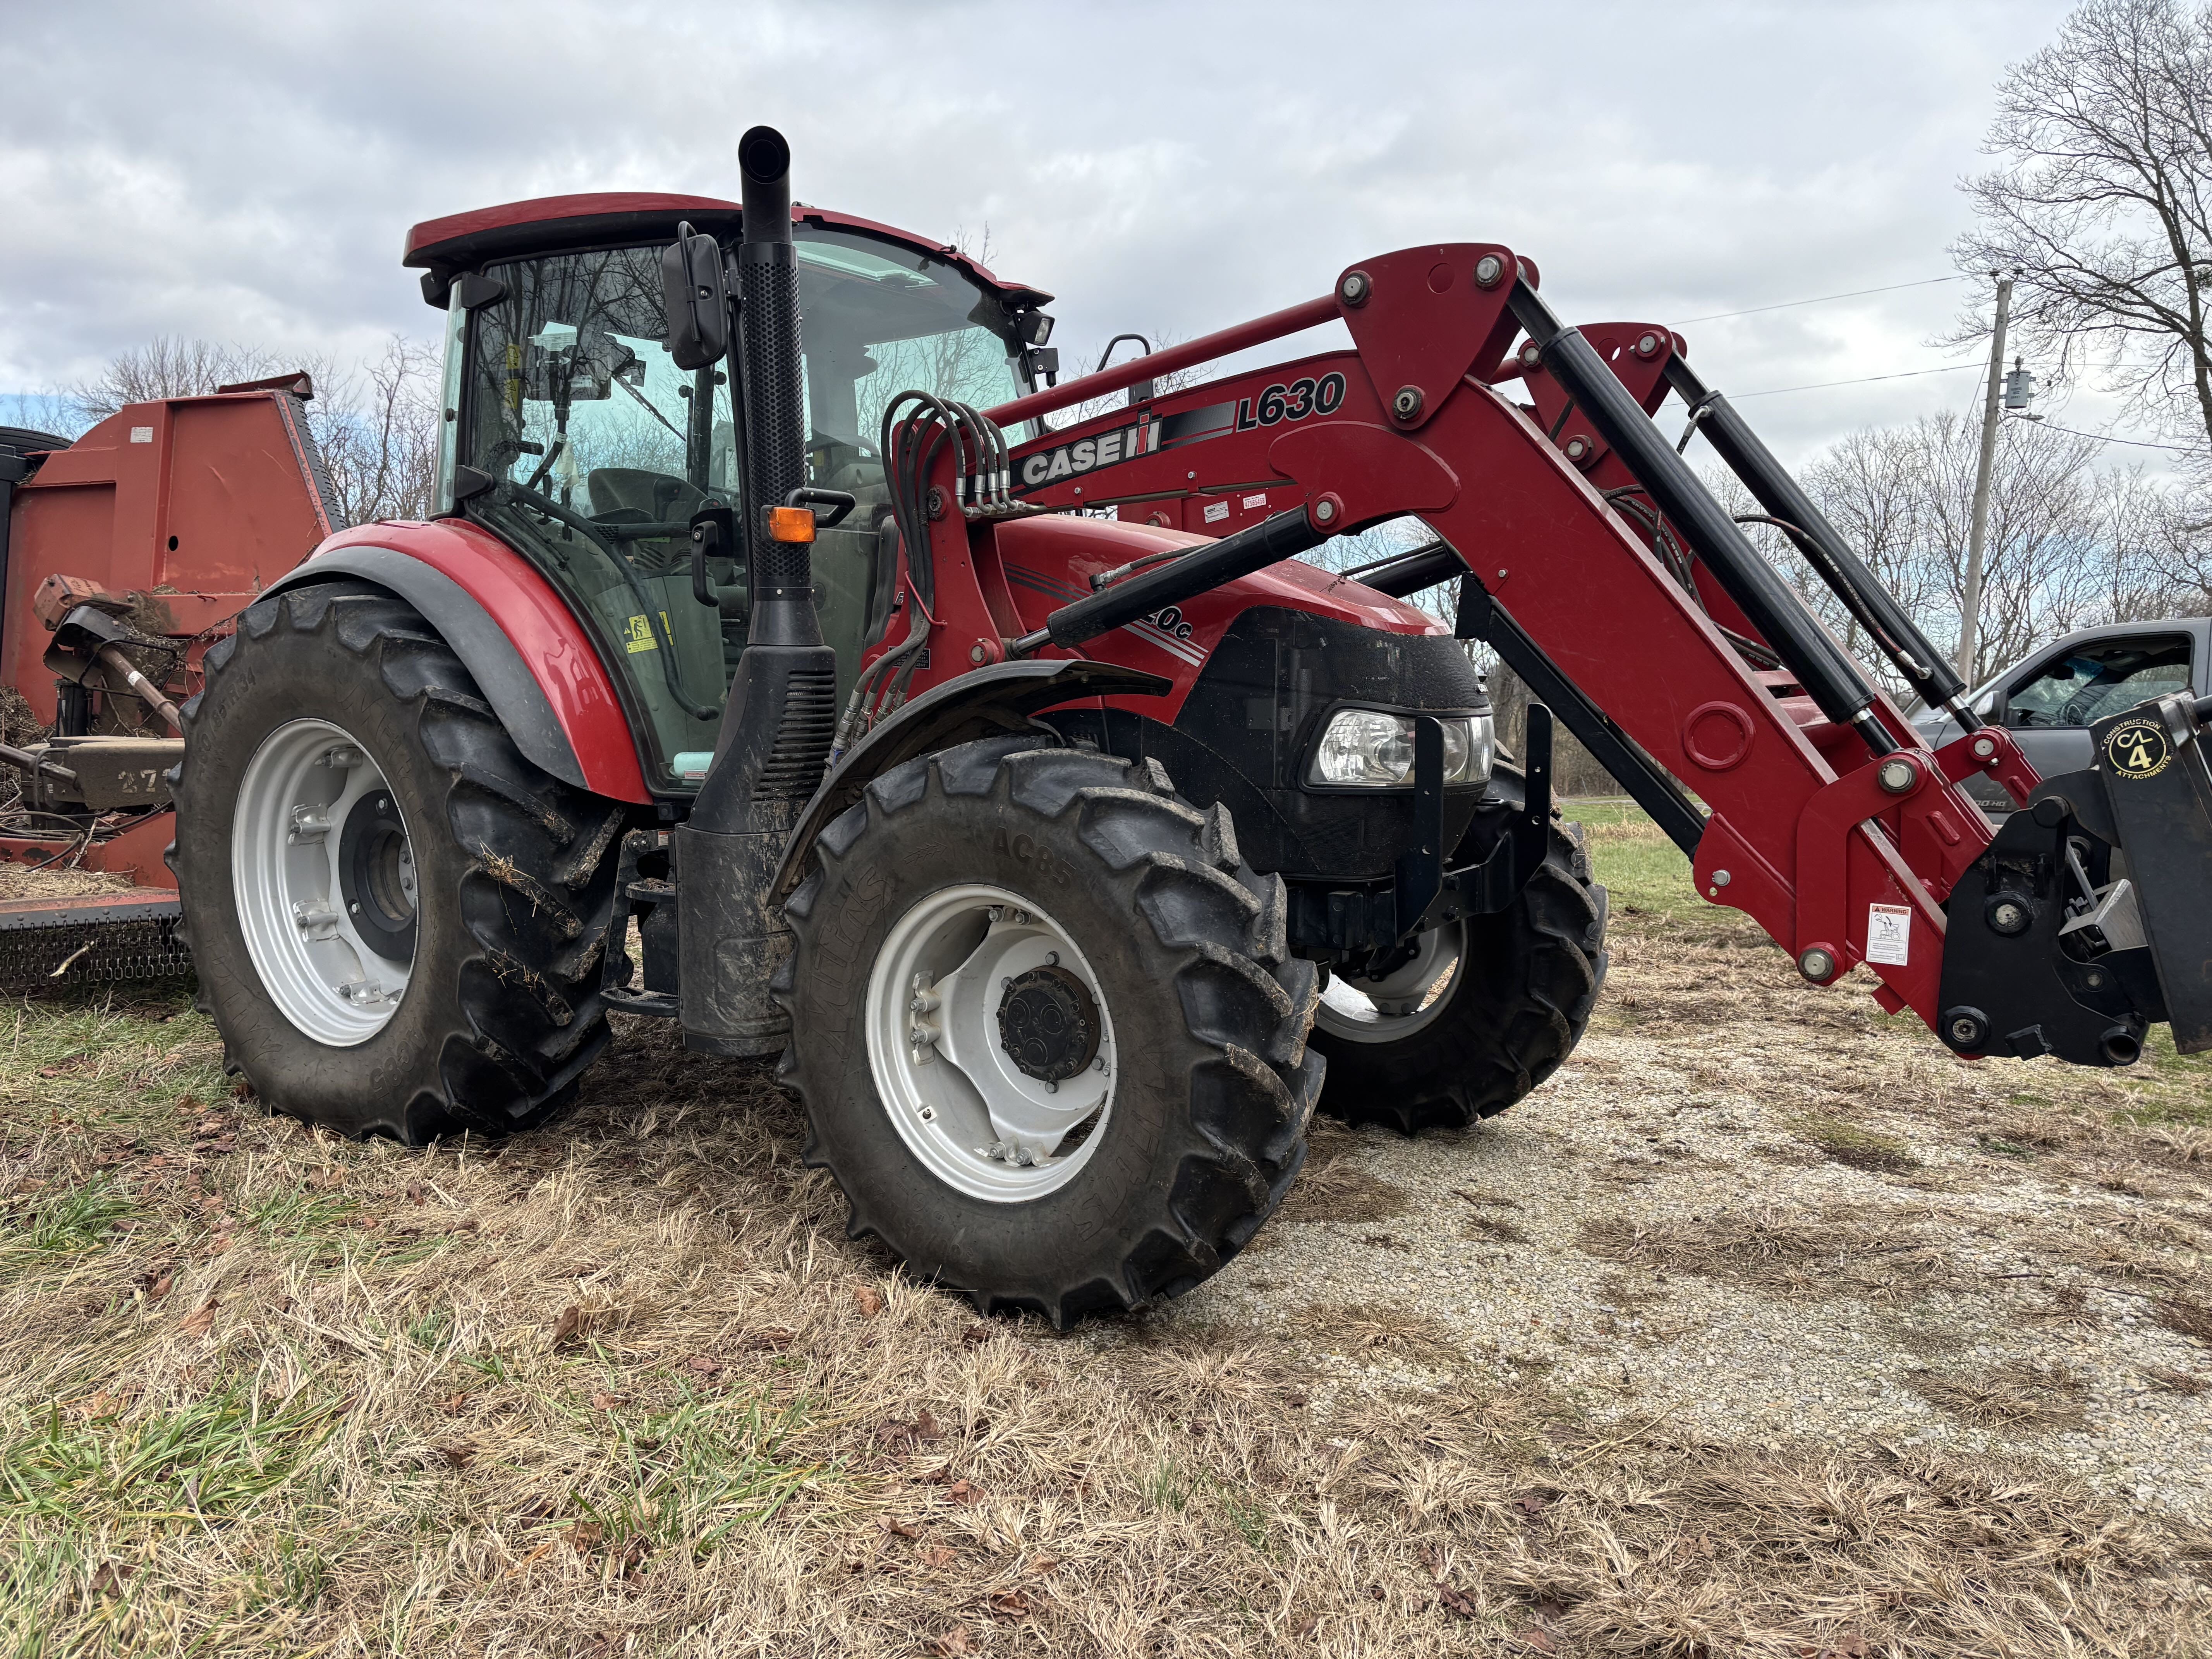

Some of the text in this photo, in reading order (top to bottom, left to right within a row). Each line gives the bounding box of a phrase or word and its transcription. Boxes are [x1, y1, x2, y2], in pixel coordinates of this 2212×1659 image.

[1236, 371, 1346, 433] L630
[1023, 433, 1121, 484] CASE
[2104, 718, 2161, 744] CONSTRUCTION
[2115, 755, 2172, 780] ATTACHMENTS
[2128, 745, 2152, 769] 4
[990, 825, 1077, 891] AC85
